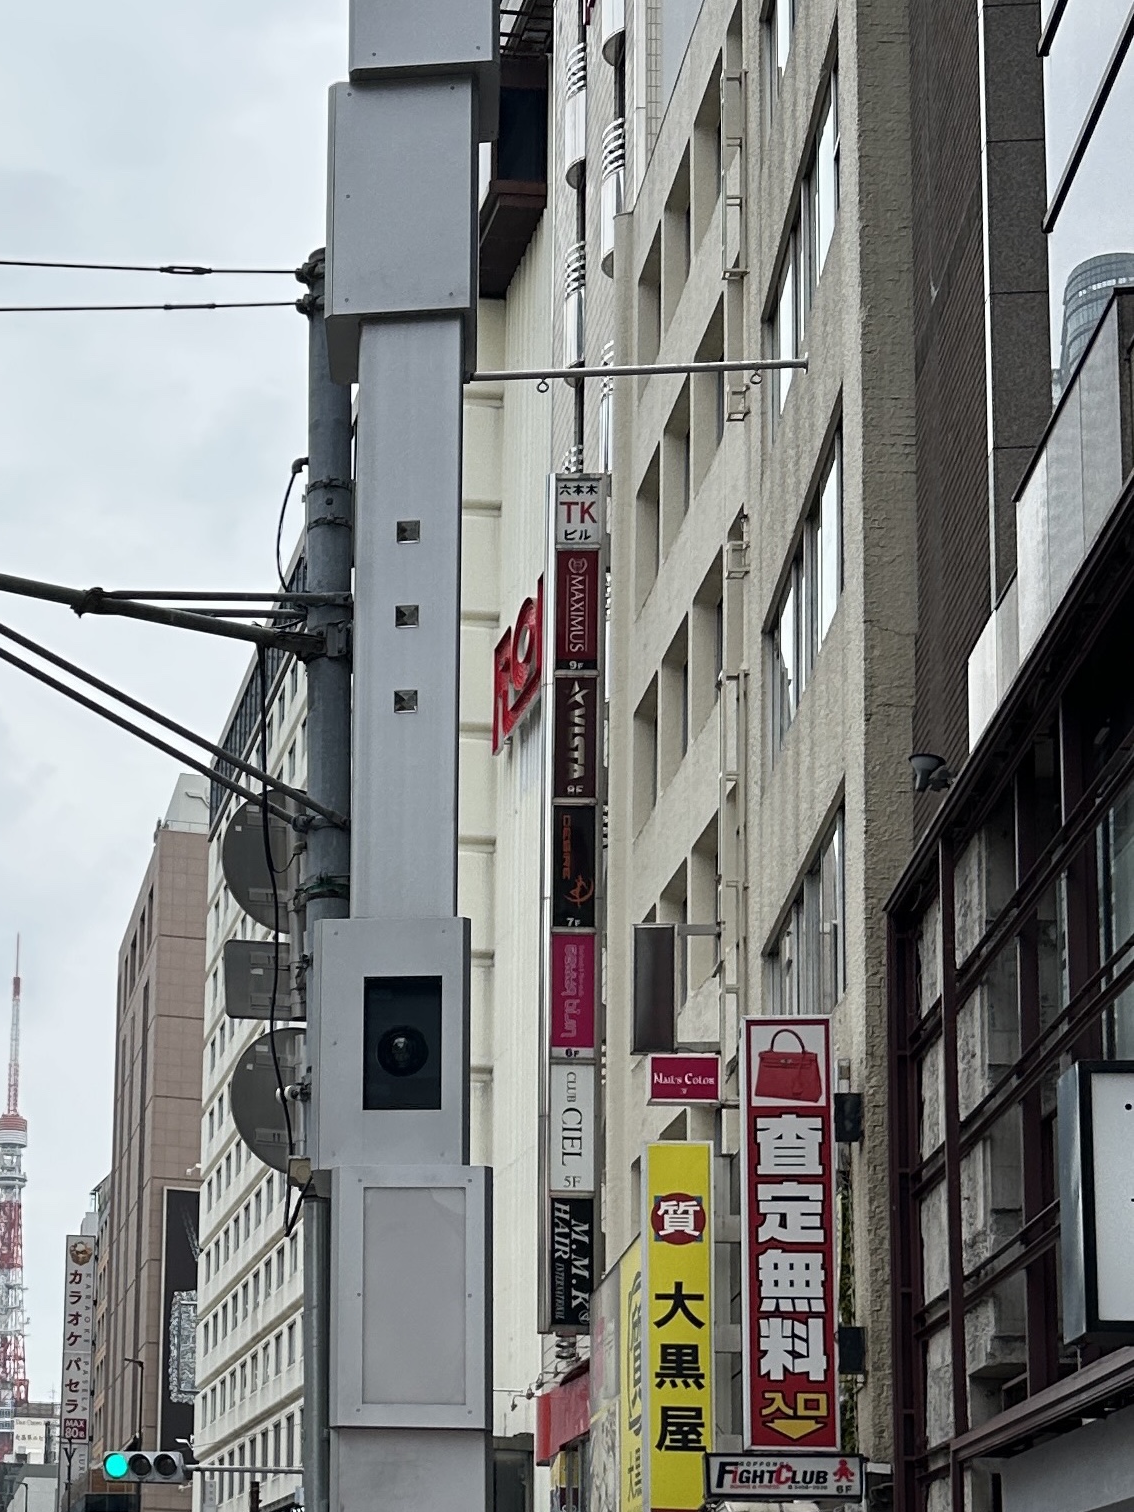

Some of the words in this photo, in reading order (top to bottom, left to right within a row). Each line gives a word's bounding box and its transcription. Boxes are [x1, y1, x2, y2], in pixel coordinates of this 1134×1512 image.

[559, 484, 598, 496] 六本木
[559, 501, 598, 524] TK
[564, 529, 591, 541] ビル
[569, 574, 586, 653] MAXIMUS
[569, 661, 584, 670] 9F
[568, 709, 586, 779] VISTA
[567, 917, 581, 926] 7F
[566, 1072, 577, 1103] CLUB
[561, 1107, 583, 1166] CIEL
[563, 1176, 582, 1188] 5F
[554, 1201, 570, 1259] HAIR
[658, 1200, 700, 1236] 質
[754, 1114, 828, 1382] 査定無料
[67, 1269, 83, 1346] カラオケ
[654, 1281, 707, 1452] 大黒屋
[64, 1357, 82, 1414] パセラ
[762, 1392, 828, 1418] 入口
[65, 1420, 85, 1428] MAX
[836, 1485, 853, 1494] 6F
